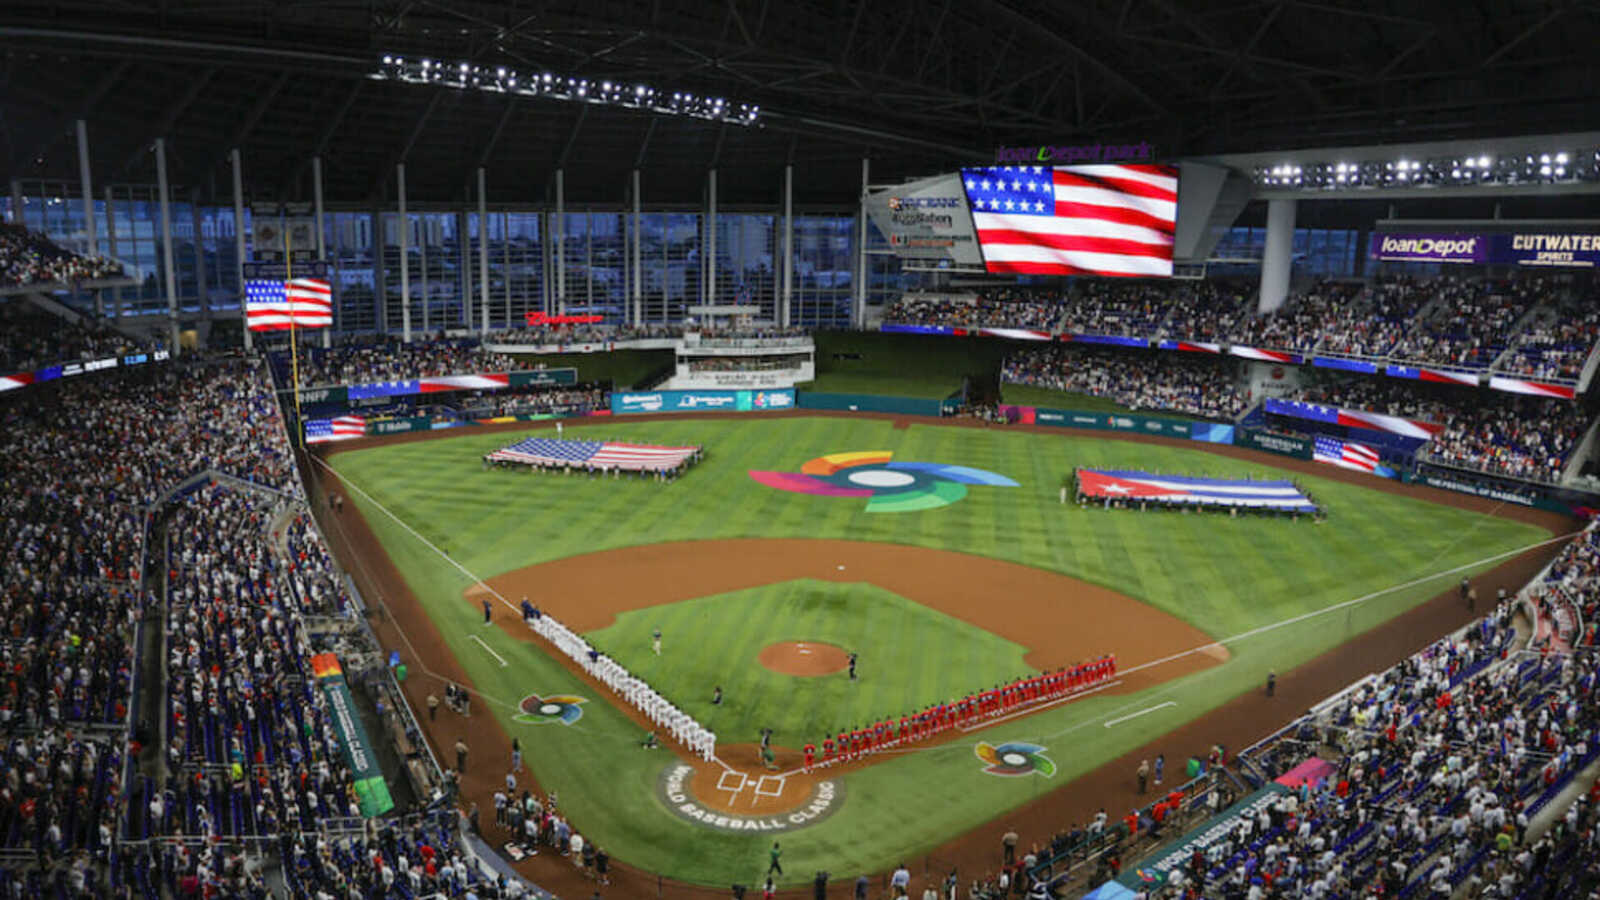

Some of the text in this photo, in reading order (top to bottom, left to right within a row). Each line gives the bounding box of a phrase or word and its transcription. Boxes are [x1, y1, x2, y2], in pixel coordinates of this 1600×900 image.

[1381, 236, 1476, 256] loanDepot
[1512, 235, 1600, 250] CUTWATER
[1537, 251, 1573, 261] SPIRITS
[667, 765, 835, 830] WORLD BASEBALL CLASSIC
